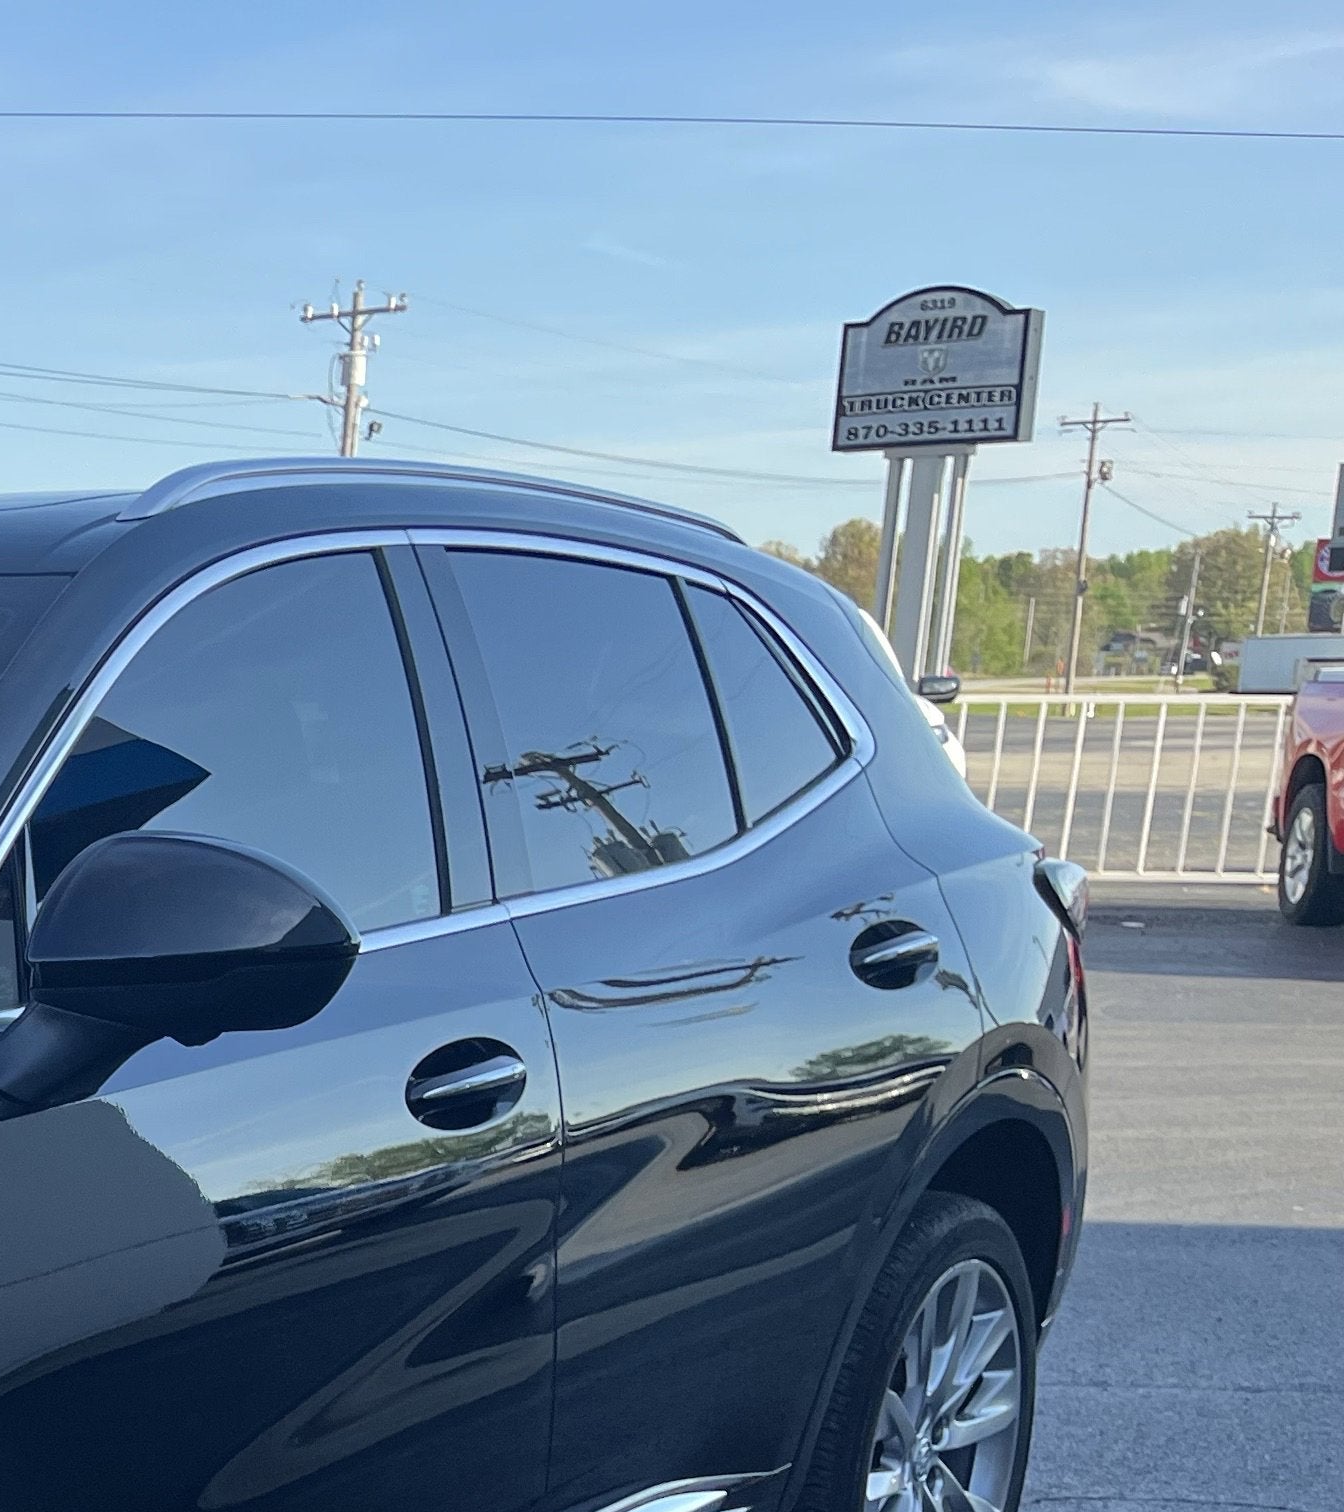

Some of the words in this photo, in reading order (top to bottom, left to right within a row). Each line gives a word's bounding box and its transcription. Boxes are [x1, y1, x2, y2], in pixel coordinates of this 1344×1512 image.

[883, 314, 988, 346] BAYIRD
[903, 375, 958, 386] RAM
[845, 393, 925, 414] TRUCK
[927, 388, 1014, 409] CENTER
[845, 416, 1008, 442] 870-335-1111
